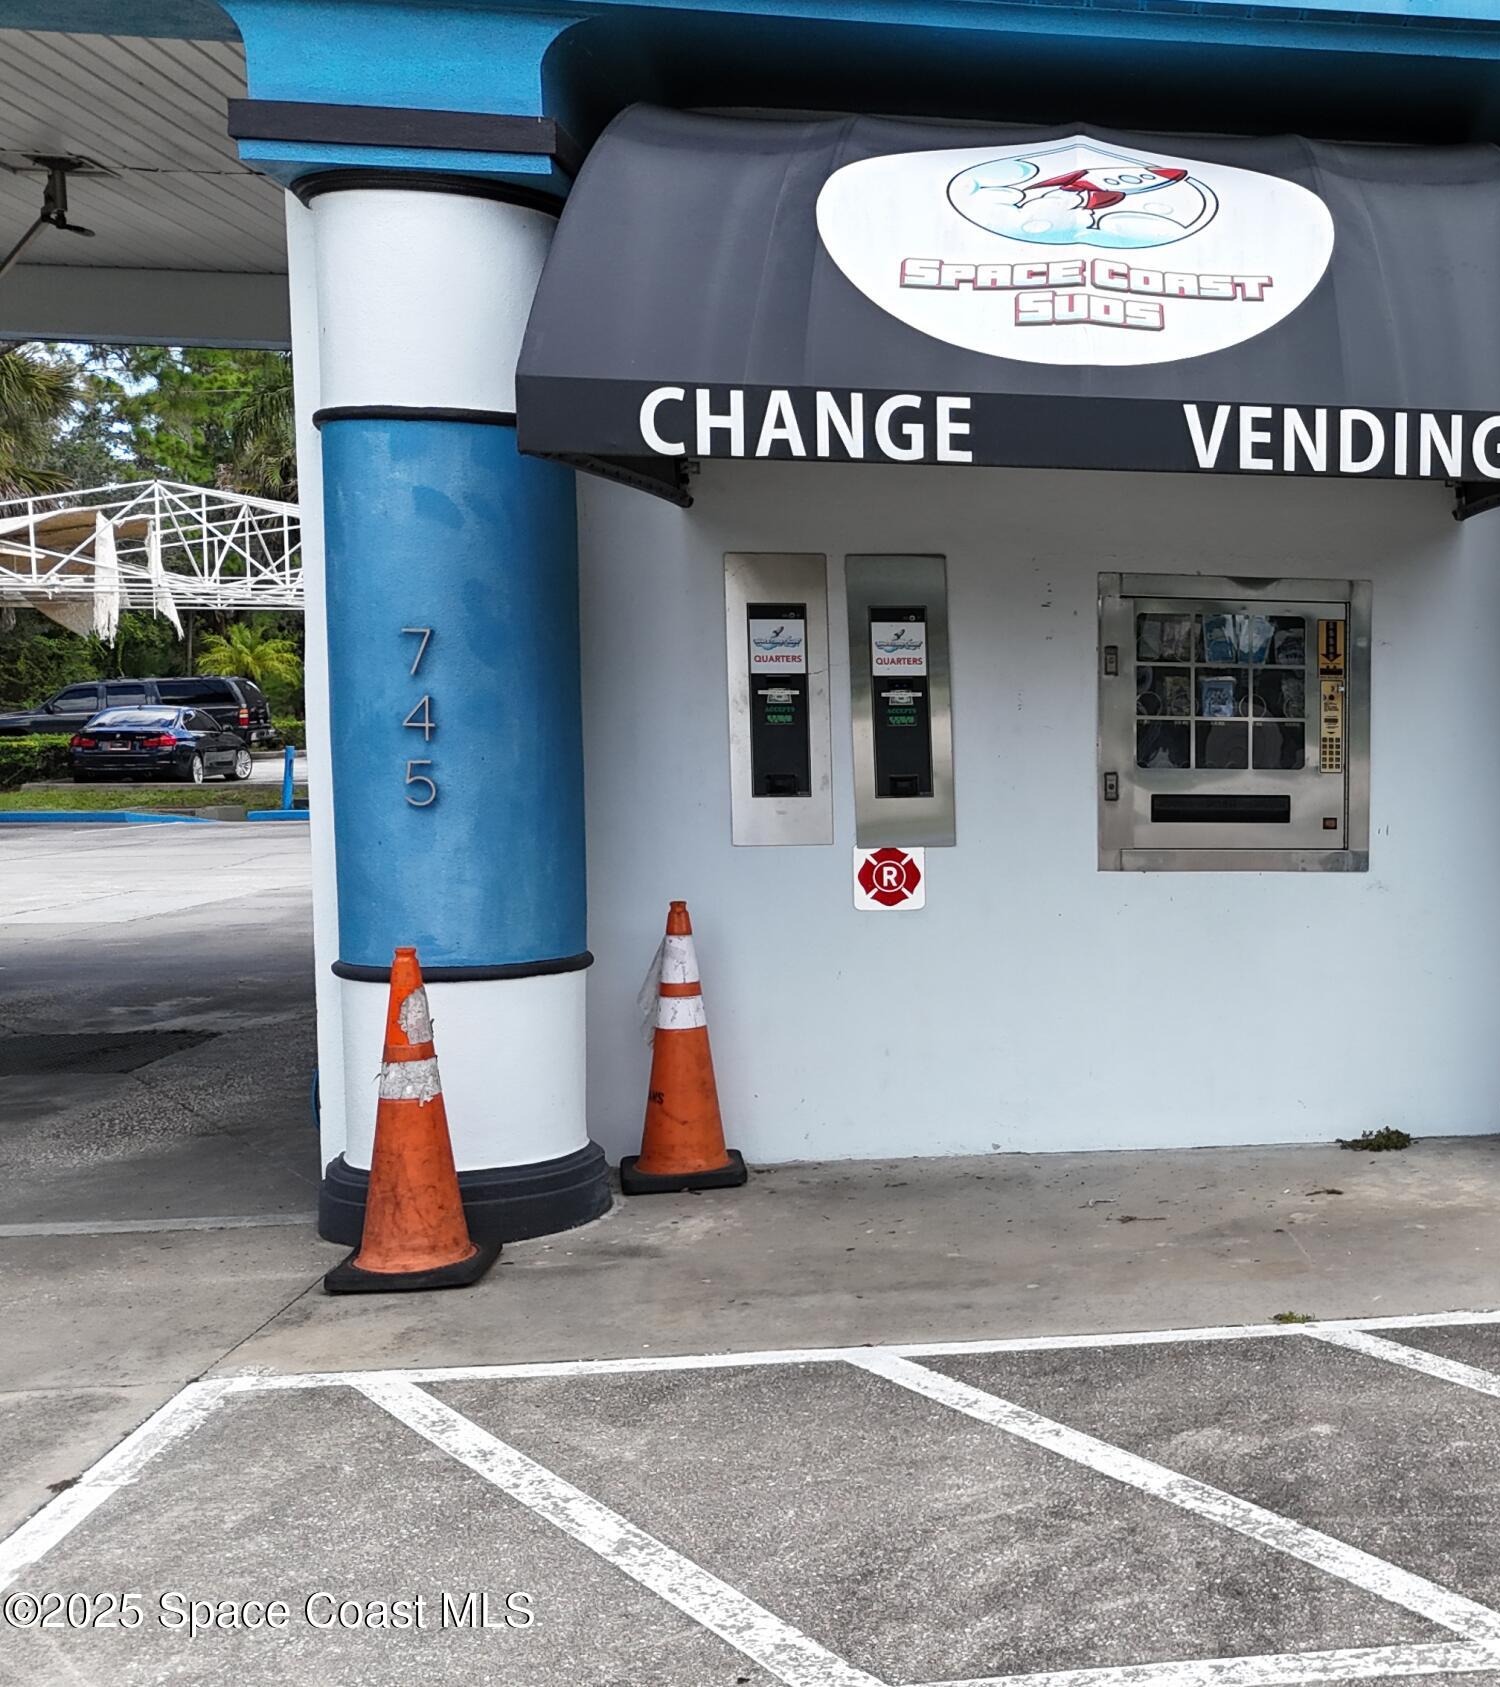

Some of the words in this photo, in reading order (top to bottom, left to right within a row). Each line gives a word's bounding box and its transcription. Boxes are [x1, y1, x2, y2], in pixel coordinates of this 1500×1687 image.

[899, 257, 1085, 291] SPACE
[1090, 257, 1273, 301] COAST
[1015, 291, 1165, 331] SUDS
[639, 386, 973, 463] CHANGE
[753, 655, 802, 663] QUARTERS
[875, 656, 924, 665] QUARTERS
[882, 865, 897, 887] R
